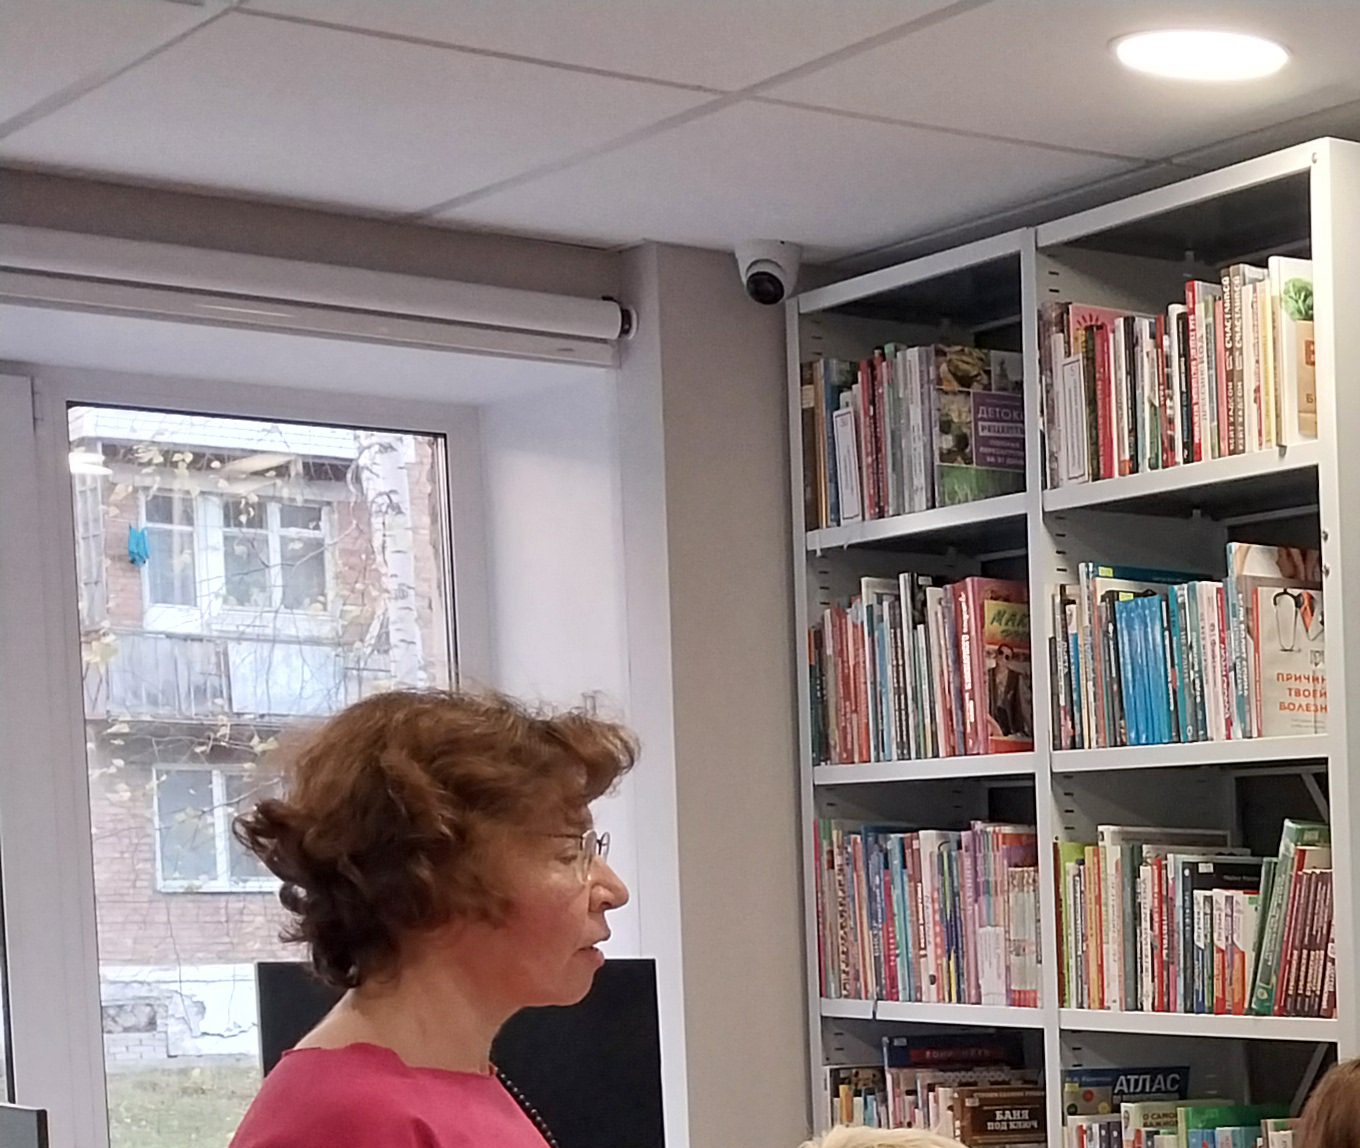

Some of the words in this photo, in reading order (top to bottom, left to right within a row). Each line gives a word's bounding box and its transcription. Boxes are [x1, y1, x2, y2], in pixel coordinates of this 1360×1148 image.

[1279, 701, 1327, 712] БОЛЕЗН
[1114, 1073, 1180, 1094] АТЛАС
[995, 1110, 1029, 1121] БАНЯ
[1151, 1112, 1177, 1120] САМО
[987, 1121, 1008, 1131] ПОД
